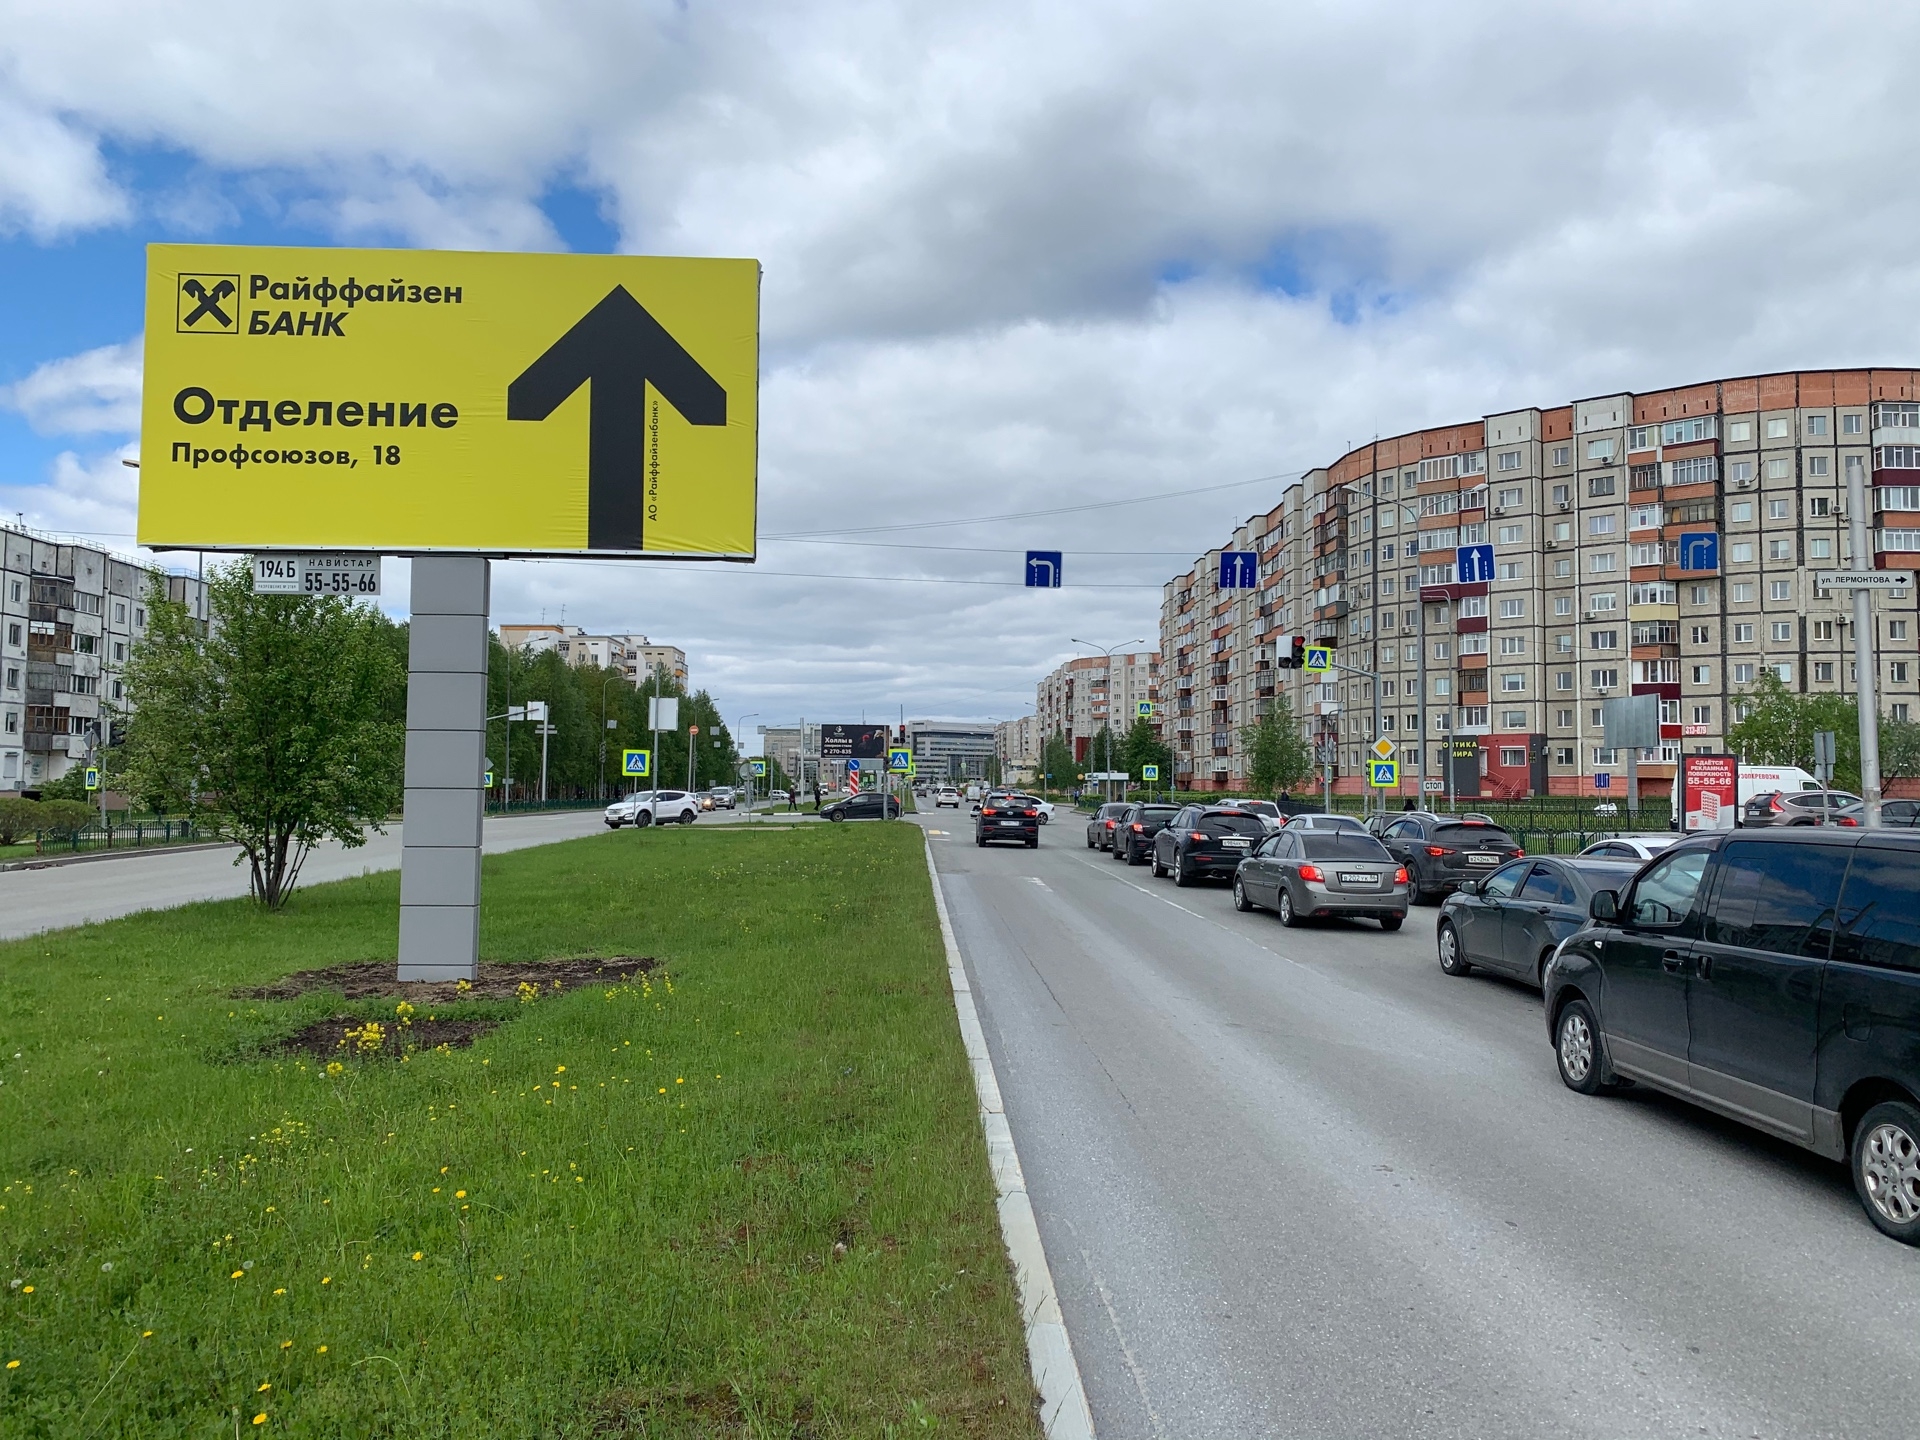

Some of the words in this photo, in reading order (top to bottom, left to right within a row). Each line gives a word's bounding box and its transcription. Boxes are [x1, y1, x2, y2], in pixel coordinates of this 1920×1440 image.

[249, 274, 463, 308] Райффайзен
[247, 310, 348, 337] БАНК
[173, 386, 459, 432] Отделение
[171, 442, 359, 471] Профсоюзов,
[373, 445, 401, 466] 18
[649, 400, 660, 502] «Райффайзенбанк»
[648, 504, 657, 521] АО
[259, 560, 284, 578] 194
[286, 560, 296, 578] Б
[308, 558, 372, 567] НАВИСТАР
[304, 572, 376, 592] 55-55-66
[1687, 777, 1732, 785] 55-55-66
